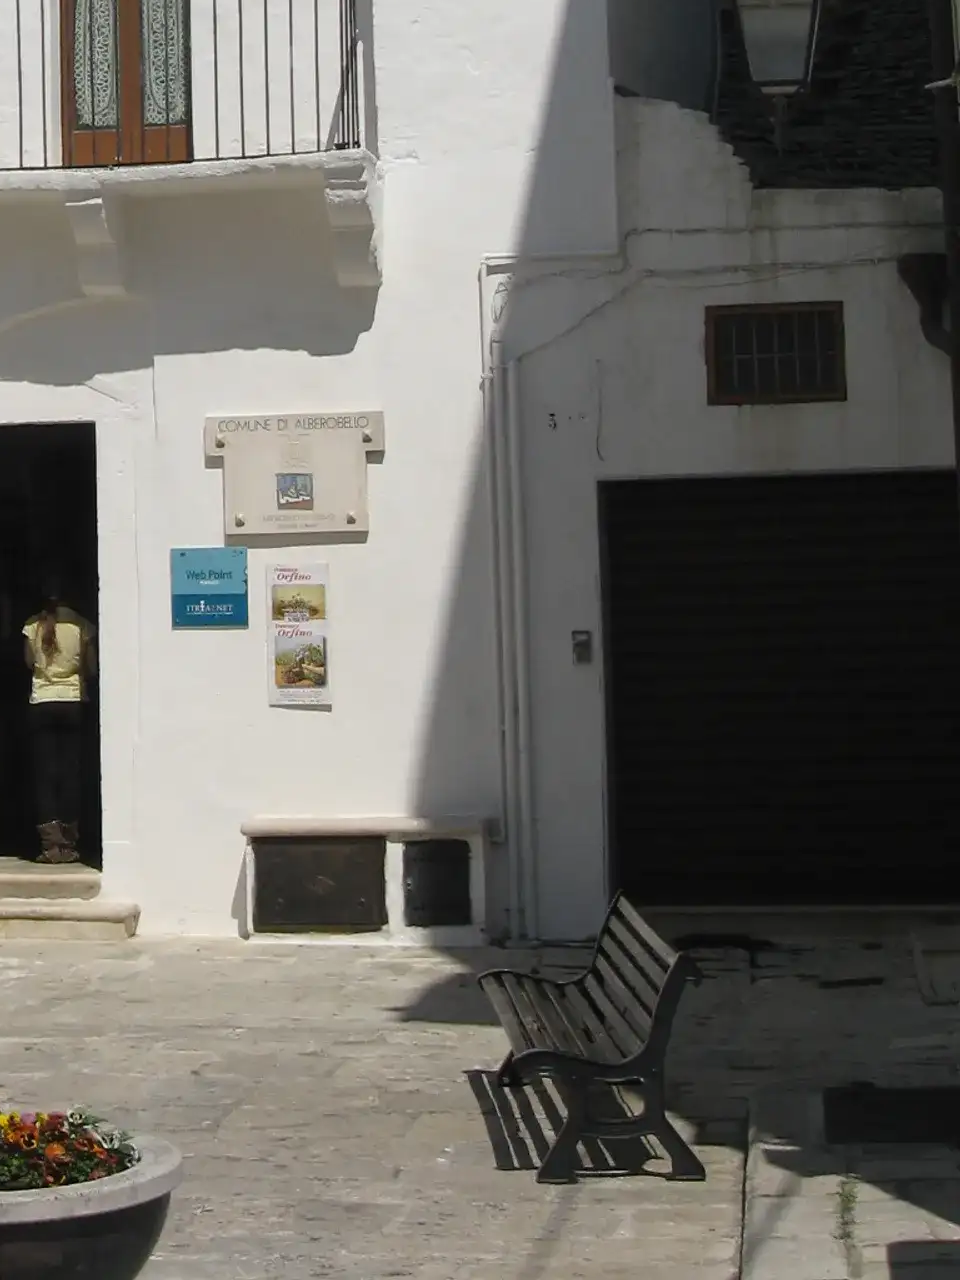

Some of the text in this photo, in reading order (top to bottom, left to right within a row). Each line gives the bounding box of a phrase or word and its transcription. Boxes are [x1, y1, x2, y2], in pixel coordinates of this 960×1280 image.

[217, 416, 369, 432] COMUNE DI ALBEROBELLO
[185, 569, 233, 580] Web Point
